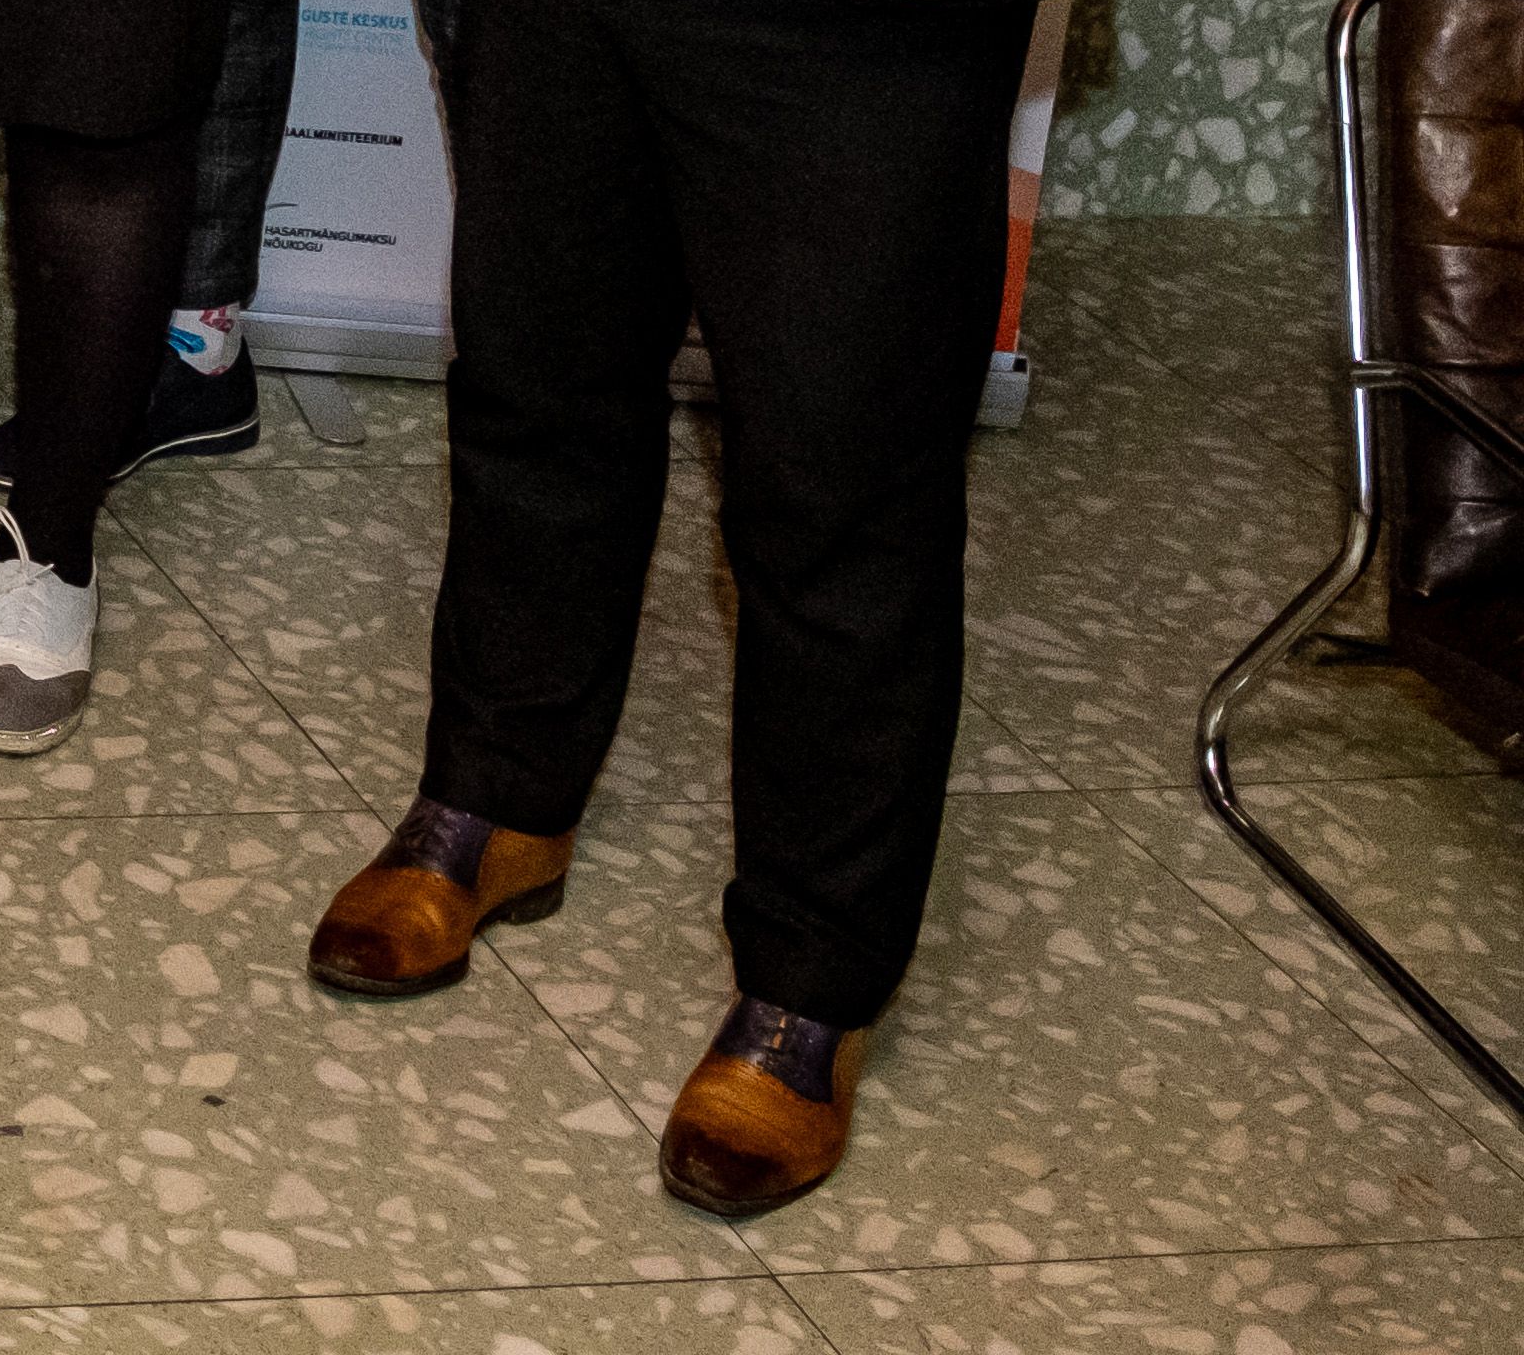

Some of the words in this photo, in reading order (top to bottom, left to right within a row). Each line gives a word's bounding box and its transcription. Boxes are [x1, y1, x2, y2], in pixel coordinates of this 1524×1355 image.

[301, 9, 349, 26] GUSTE
[351, 13, 408, 30] KESKUS
[284, 125, 403, 147] IAALMINISTEERIUM
[262, 237, 324, 252] NÕUKOGU
